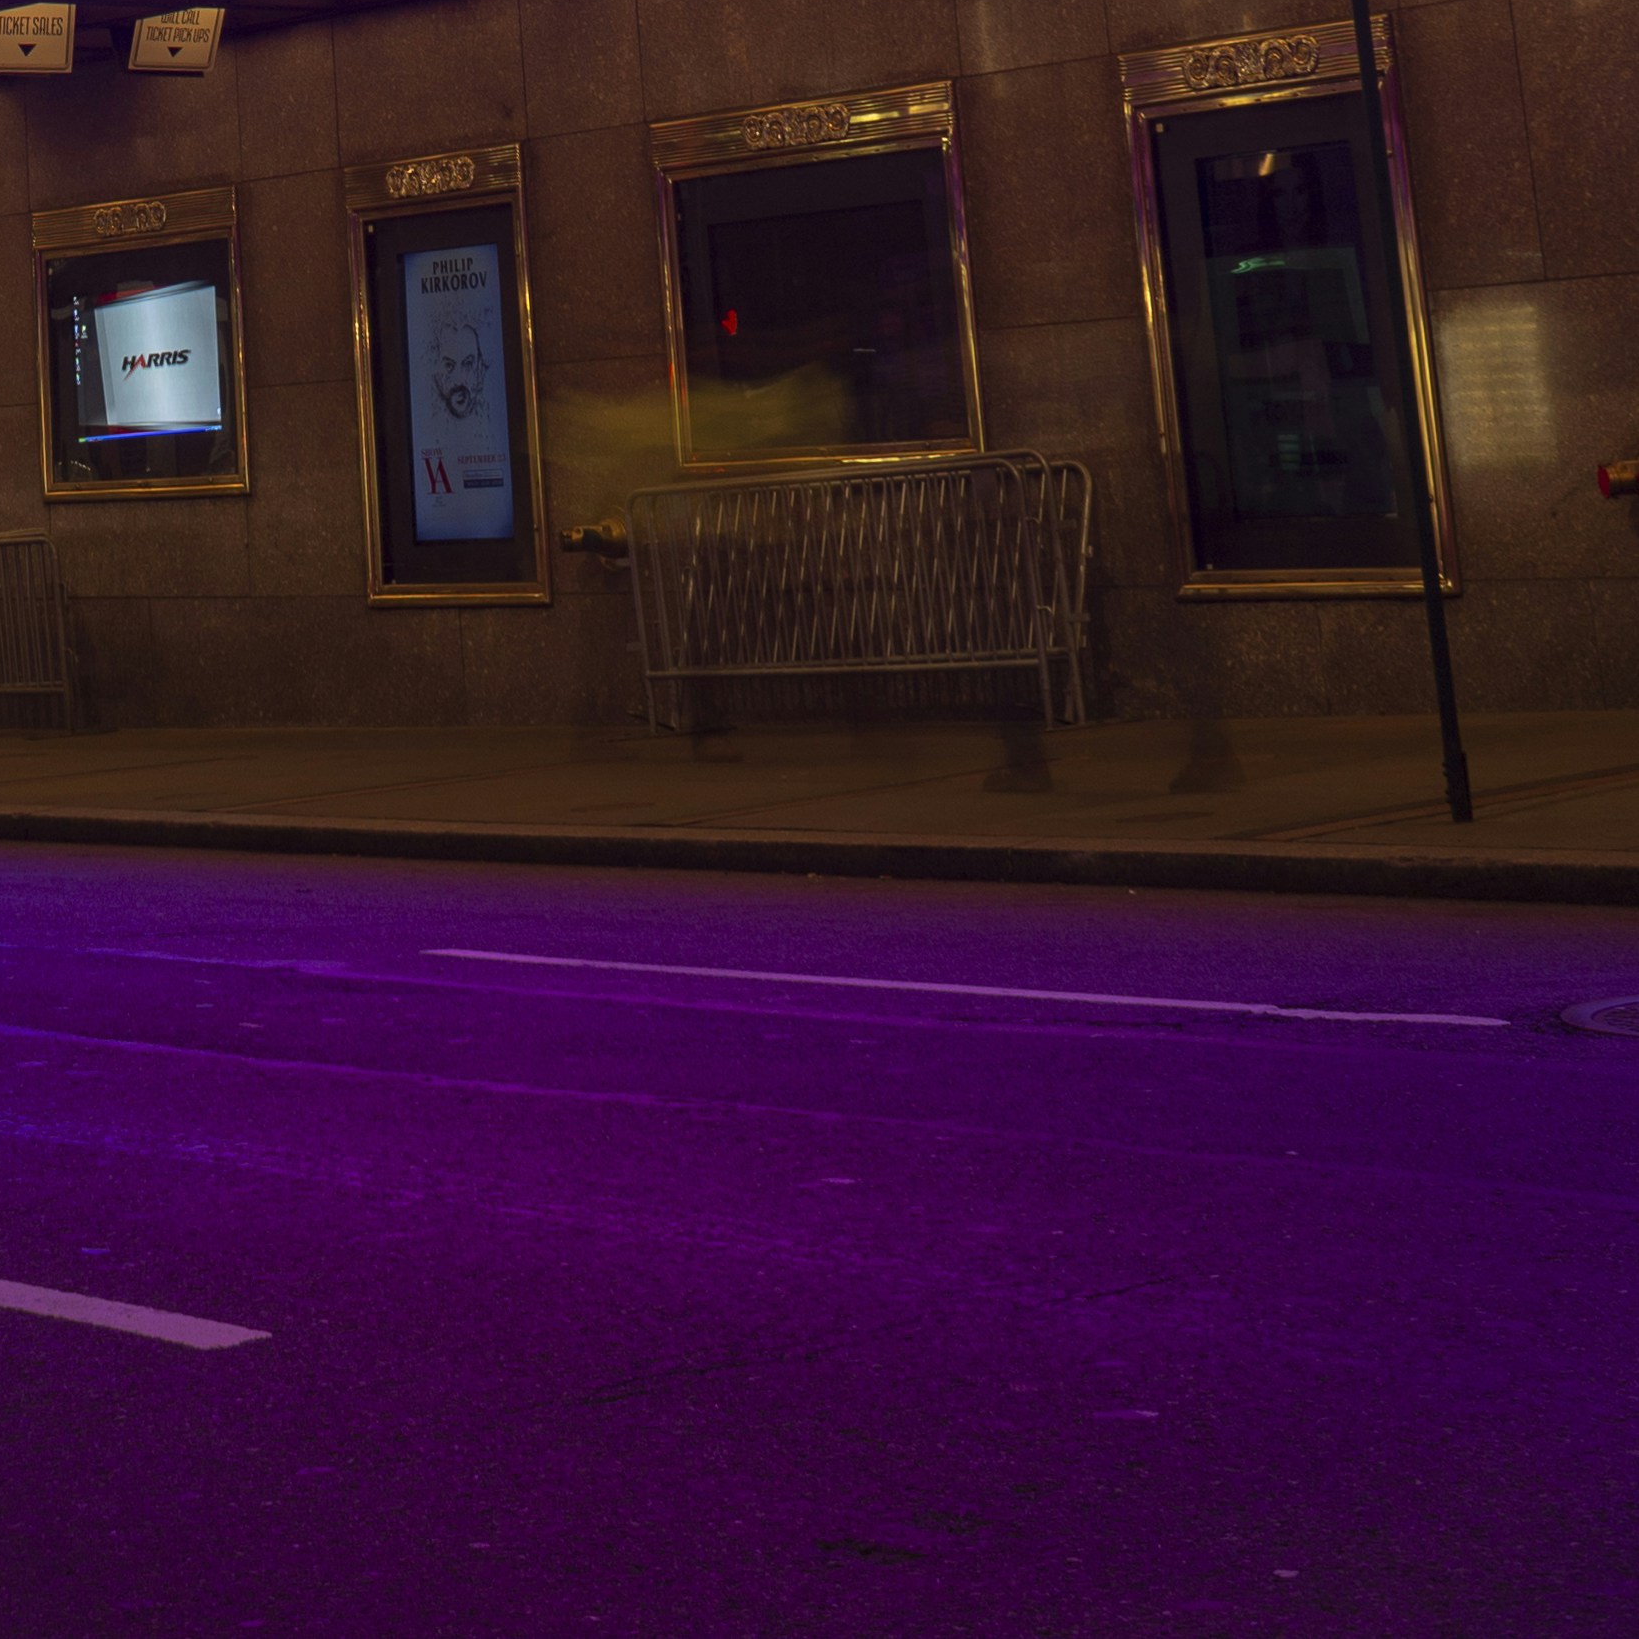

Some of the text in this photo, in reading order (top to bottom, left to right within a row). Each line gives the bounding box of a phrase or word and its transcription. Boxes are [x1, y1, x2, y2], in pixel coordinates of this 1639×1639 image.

[32, 16, 63, 36] SALES
[181, 9, 201, 26] CALL
[146, 26, 211, 43] TICKET PICK UPS
[432, 257, 474, 275] PHILIP
[421, 271, 488, 295] KIRKOROV
[121, 348, 192, 381] HARRIS
